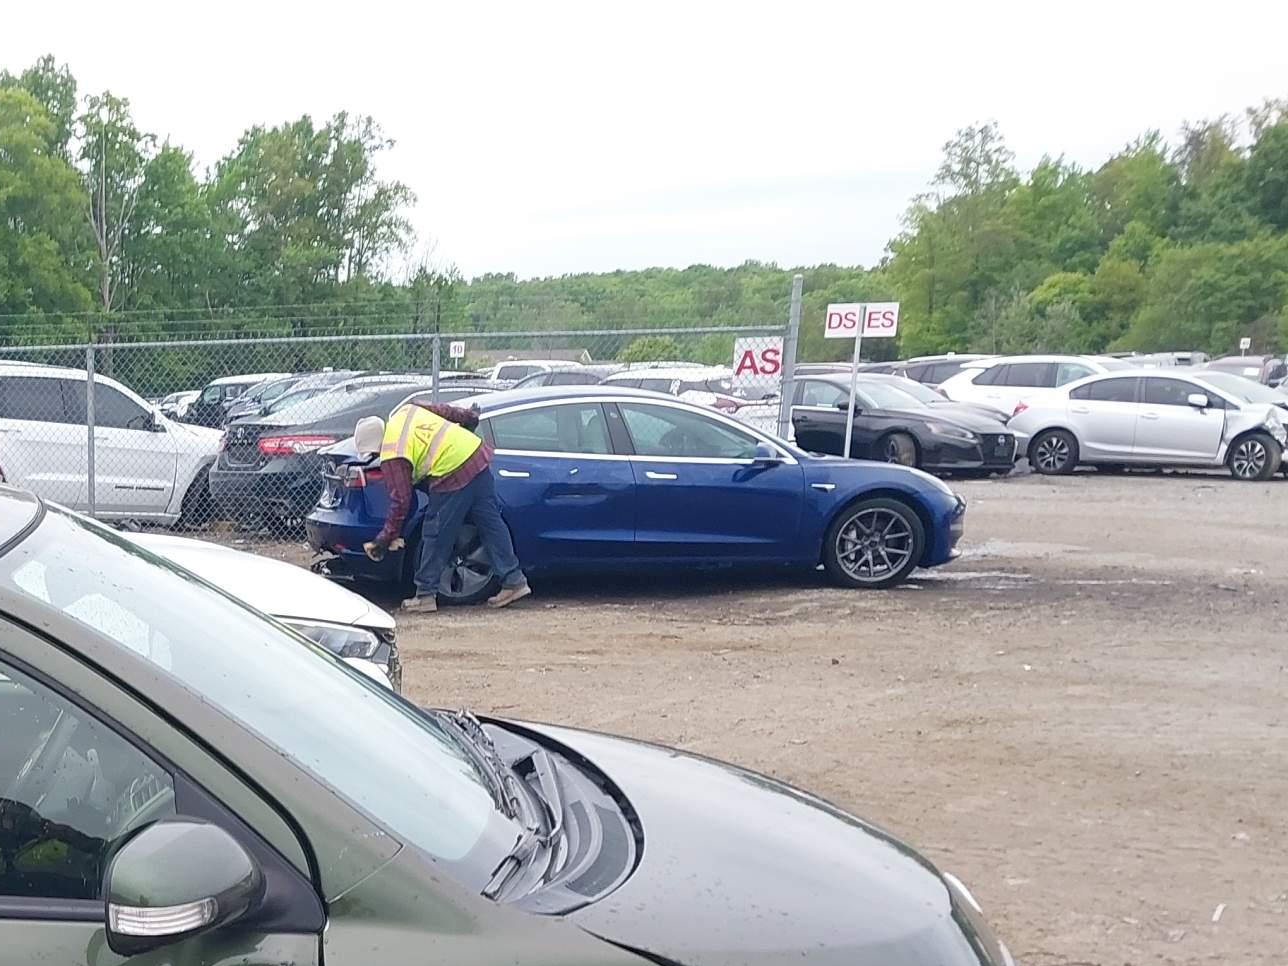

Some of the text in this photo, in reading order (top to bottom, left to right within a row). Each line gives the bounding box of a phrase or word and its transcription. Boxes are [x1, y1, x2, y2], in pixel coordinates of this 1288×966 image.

[827, 312, 857, 329] DS
[866, 311, 895, 329] ES
[735, 348, 781, 377] AS
